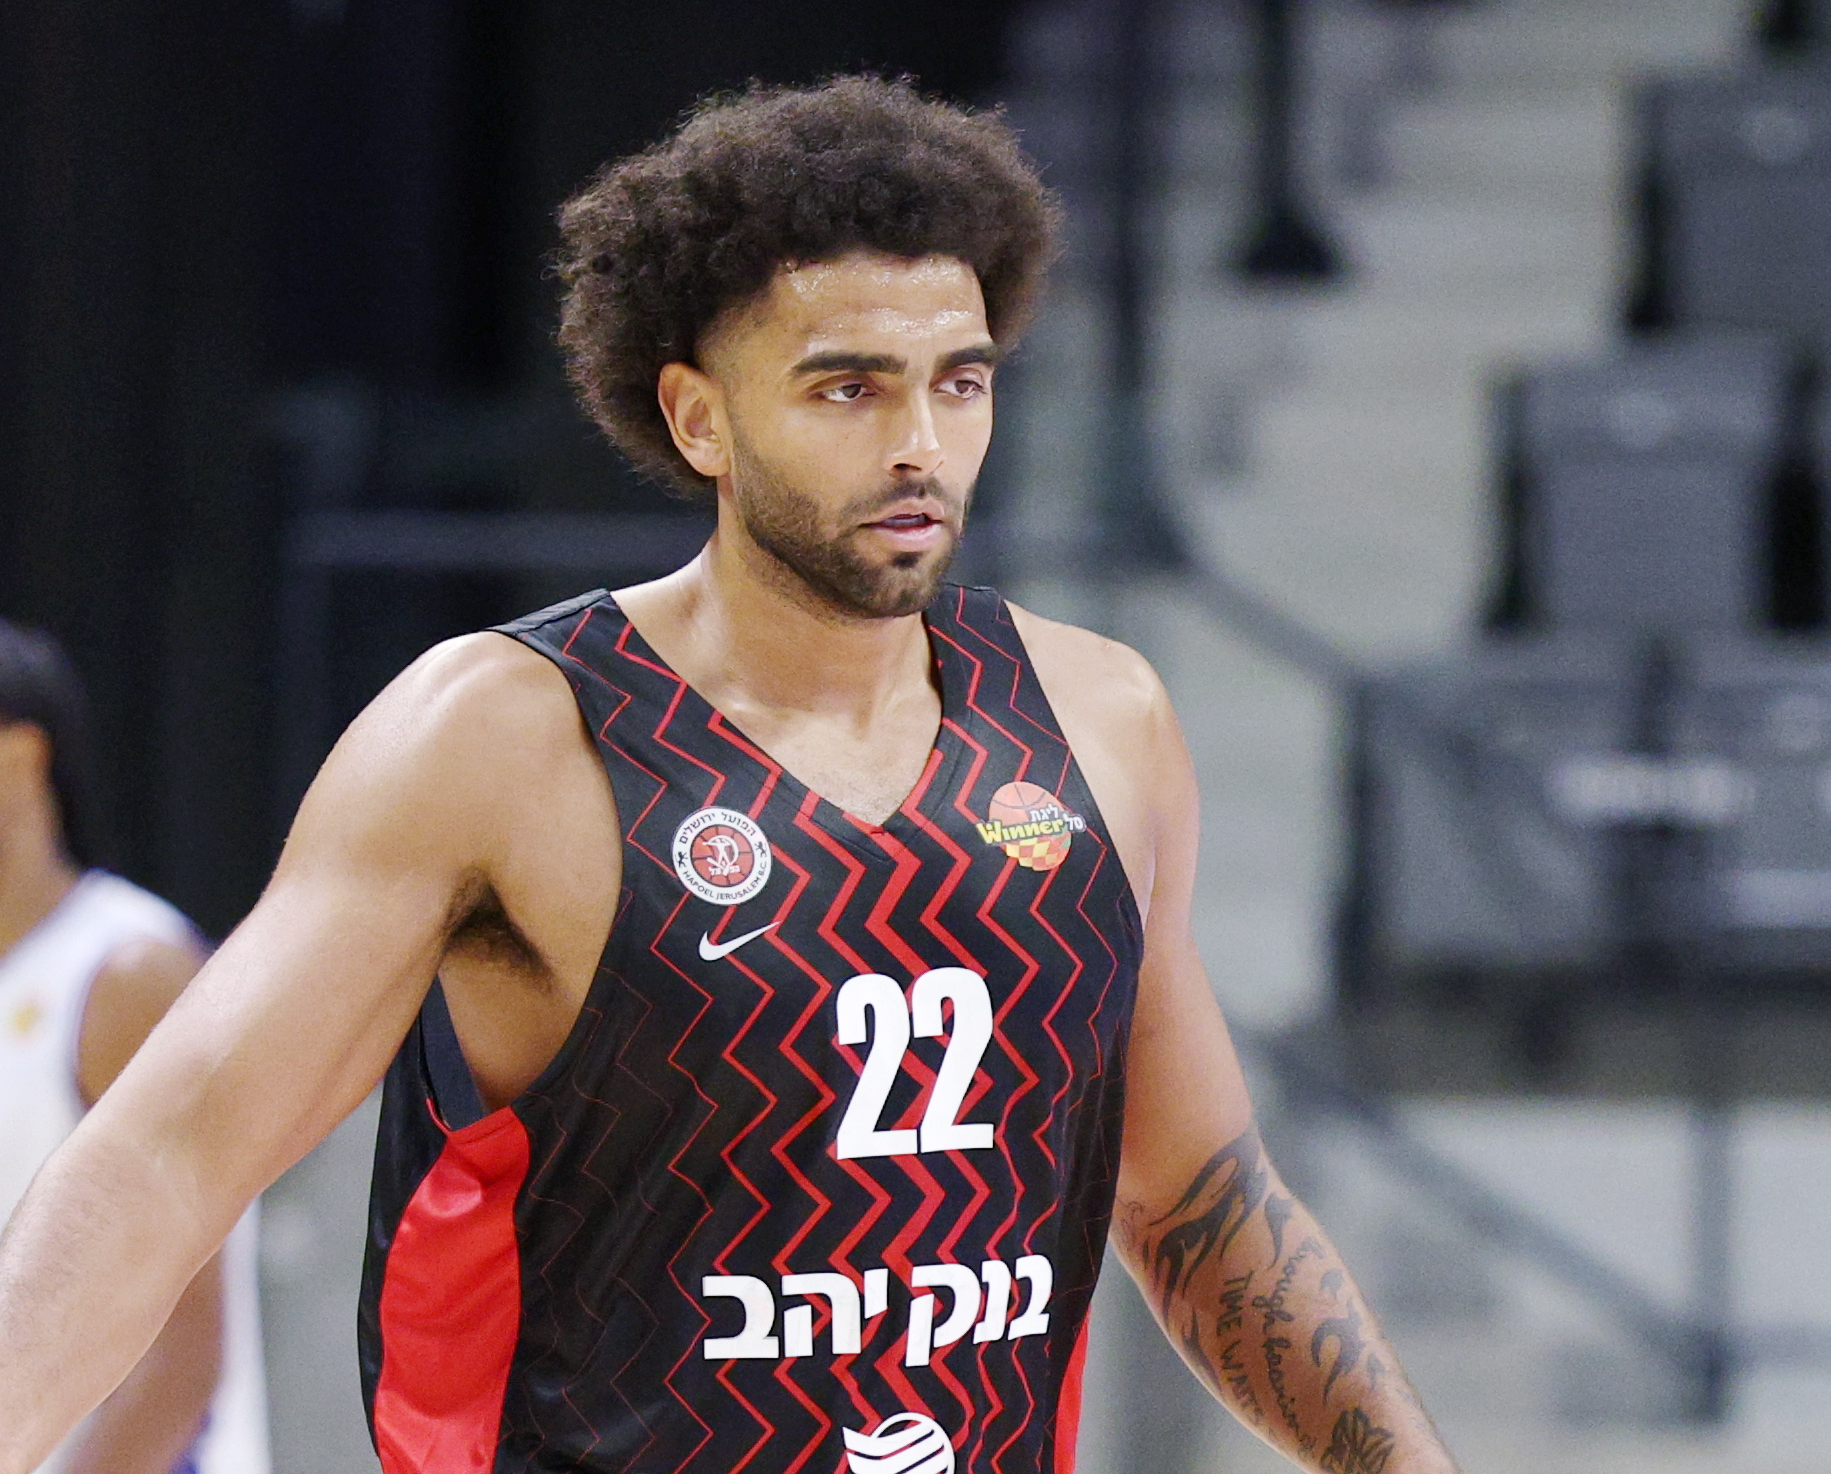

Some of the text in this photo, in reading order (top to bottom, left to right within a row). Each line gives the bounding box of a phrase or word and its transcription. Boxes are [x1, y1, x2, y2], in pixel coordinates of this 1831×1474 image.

[1030, 803, 1059, 822] ליגת
[1062, 813, 1084, 831] סל
[679, 812, 757, 844] הפועל ירושלים
[976, 819, 1064, 844] Winner
[683, 871, 714, 898] HAPOEL
[716, 877, 761, 900] JERUSALEM
[836, 967, 994, 1160] 22
[702, 1254, 1054, 1367] בנק יהב
